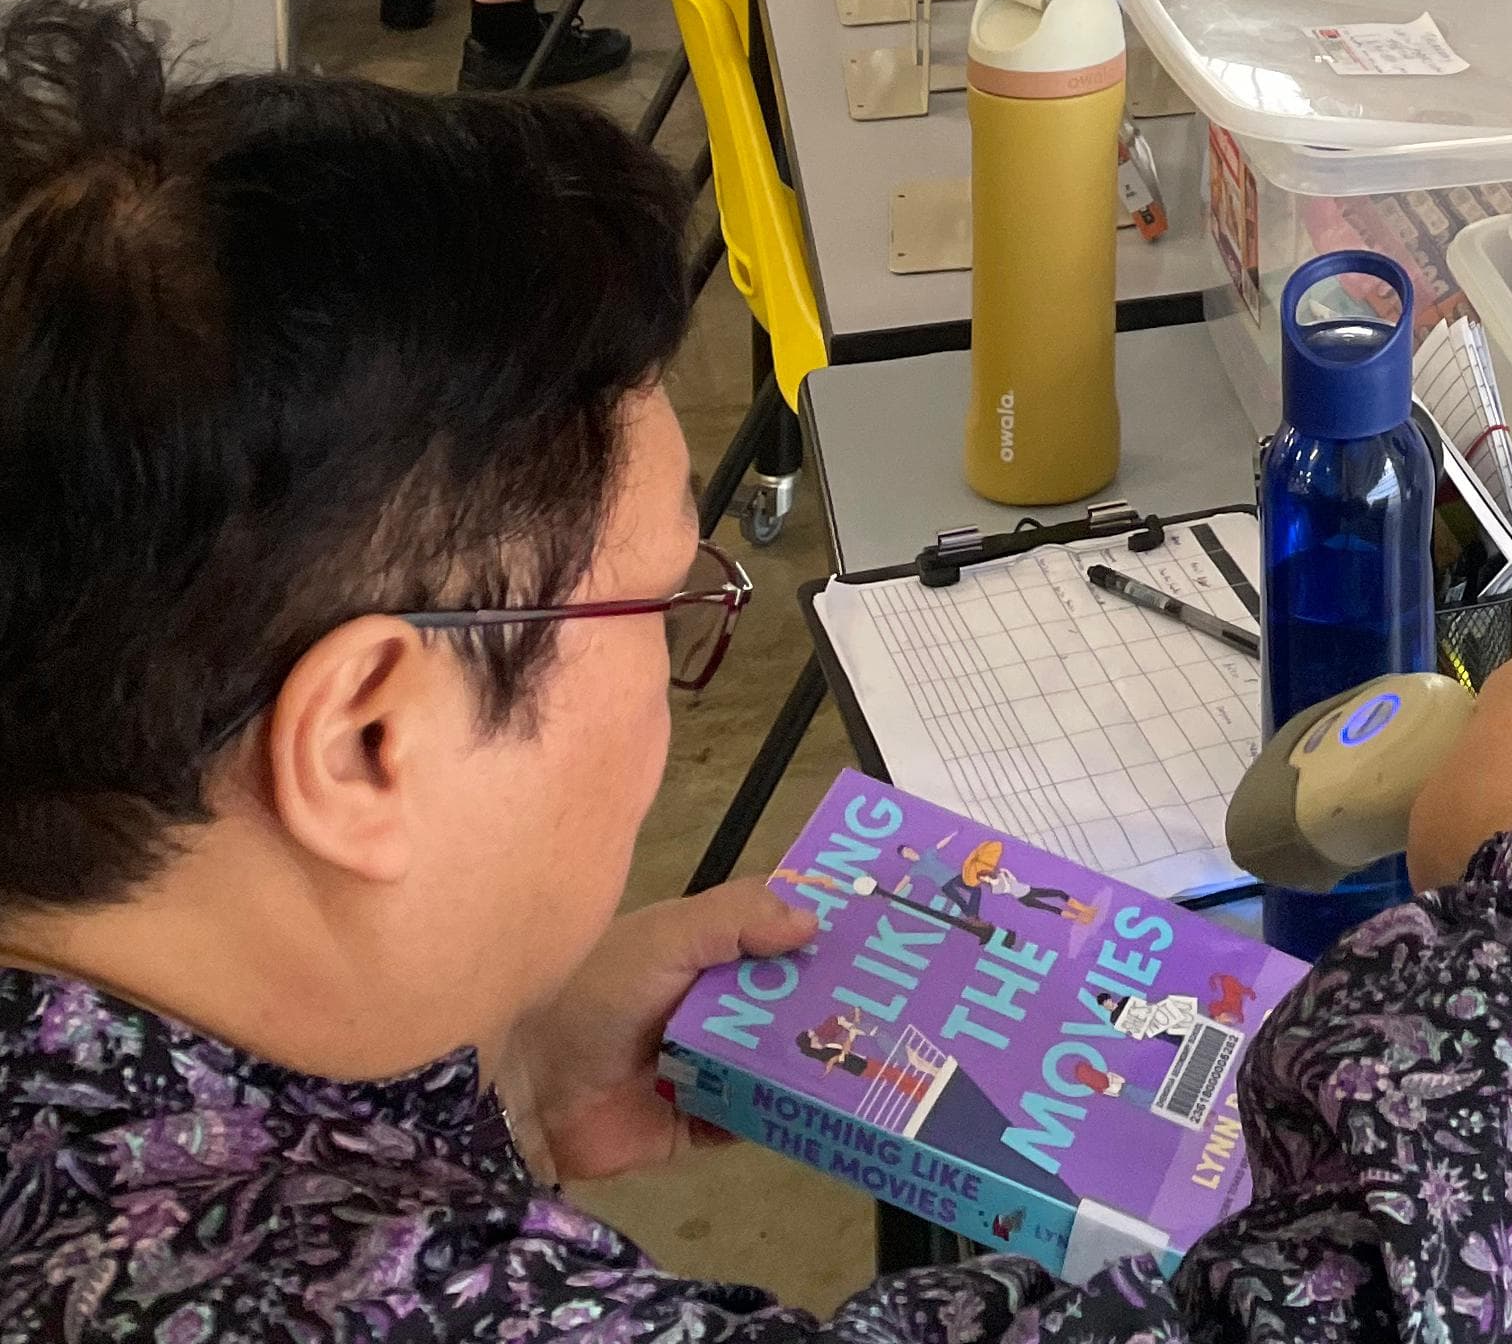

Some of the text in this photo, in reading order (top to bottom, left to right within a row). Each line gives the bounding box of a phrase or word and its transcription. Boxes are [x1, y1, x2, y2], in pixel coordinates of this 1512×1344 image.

[996, 390, 1014, 464] owala
[702, 796, 903, 1049] NOHING
[940, 927, 1058, 1050] THE
[1000, 906, 1174, 1174] MOVIES
[752, 1083, 982, 1202] NOTHING LIKE
[760, 1117, 959, 1226] THE MOVIES
[1191, 1114, 1243, 1190] LYNN
